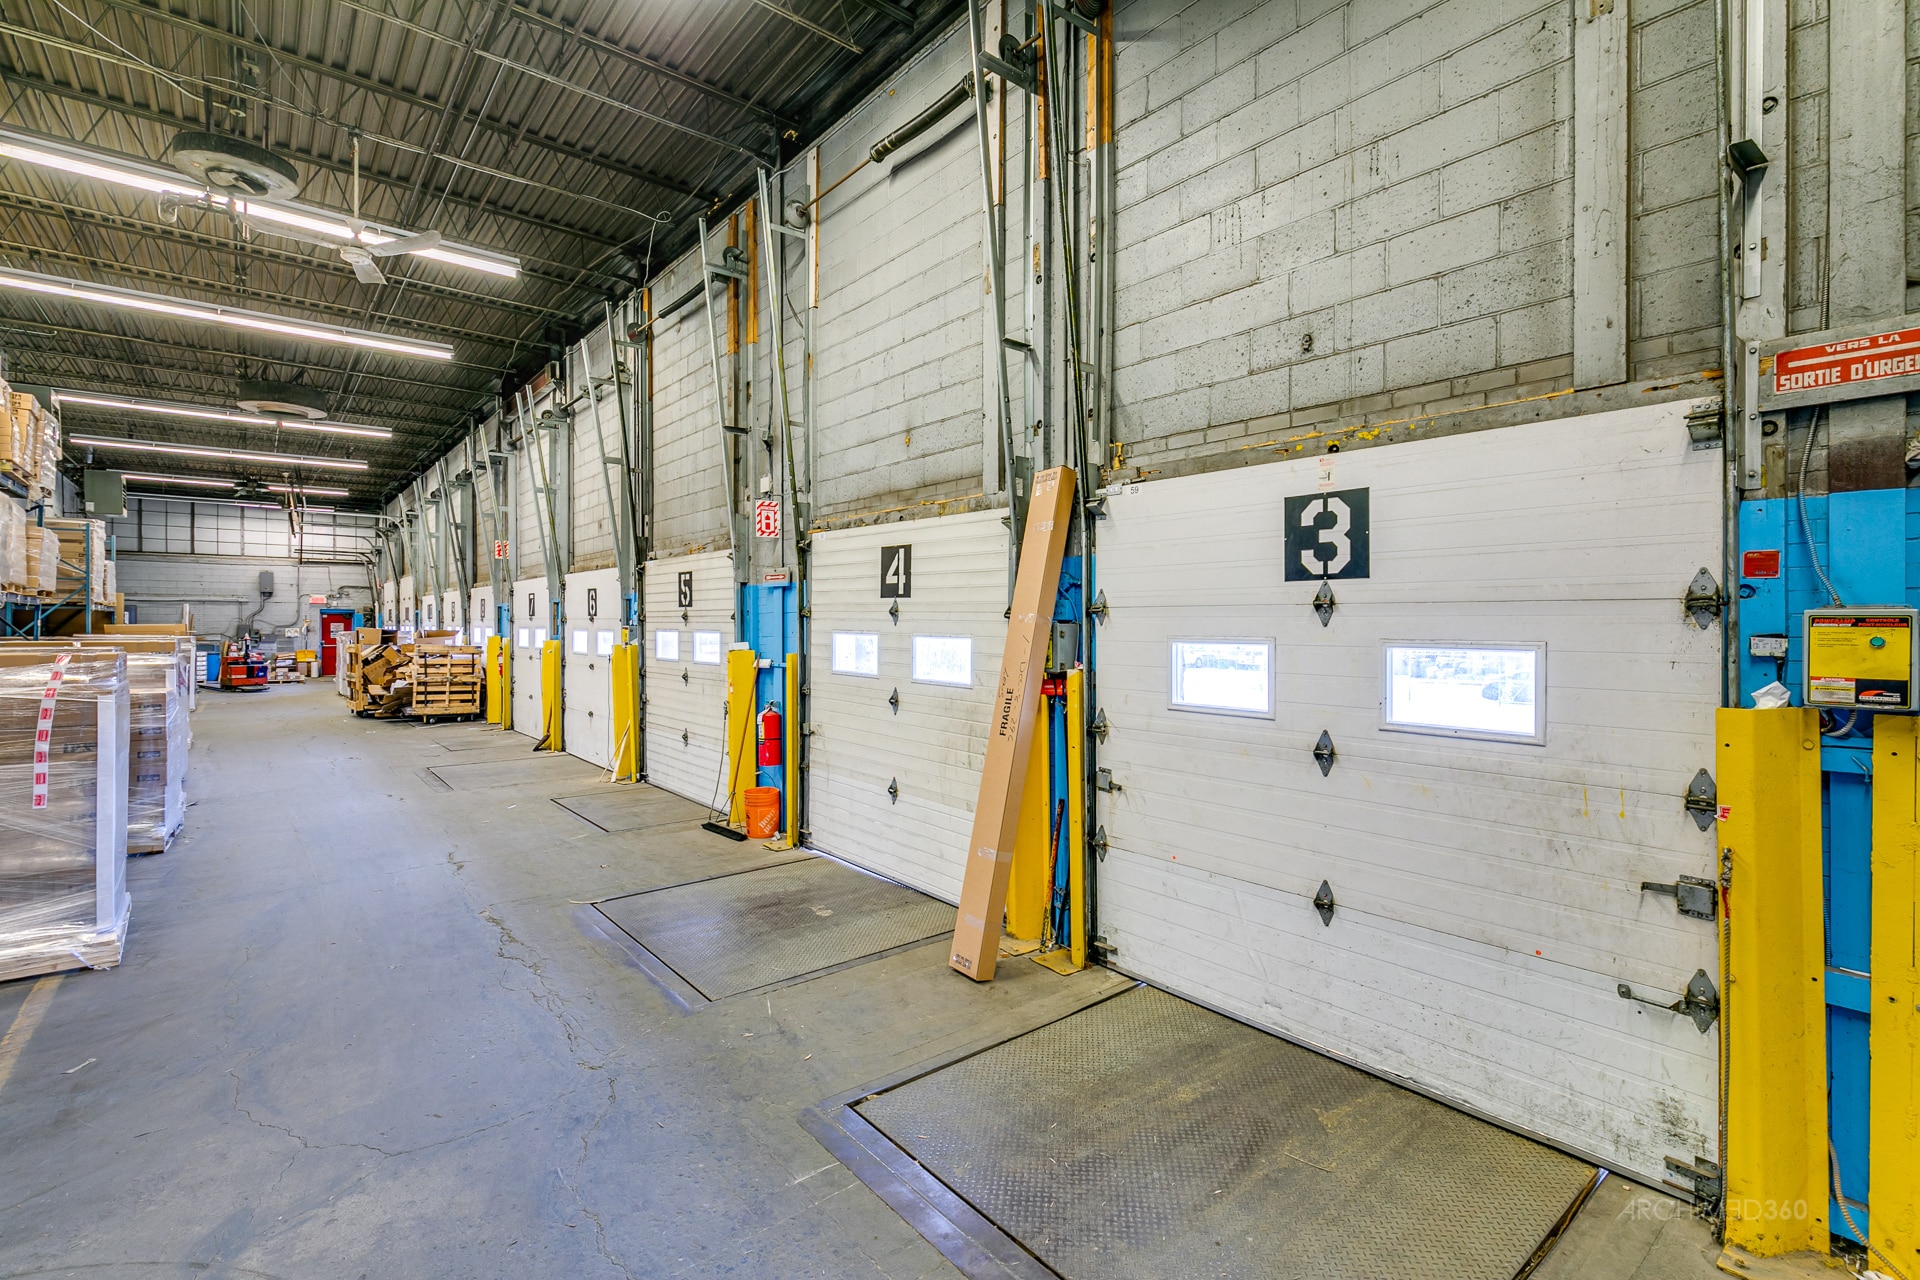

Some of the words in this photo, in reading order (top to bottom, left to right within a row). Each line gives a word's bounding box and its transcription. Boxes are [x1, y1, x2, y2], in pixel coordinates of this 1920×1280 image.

[1825, 339, 1871, 353] VERS
[1878, 334, 1901, 345] LA
[1779, 366, 1842, 391] SORTIE
[1130, 486, 1139, 494] 59
[1301, 497, 1351, 575] 3
[885, 548, 906, 595] 4
[681, 573, 690, 606] 5
[529, 595, 535, 615] 7
[589, 591, 596, 615] 6
[999, 687, 1015, 737] FRAGILE
